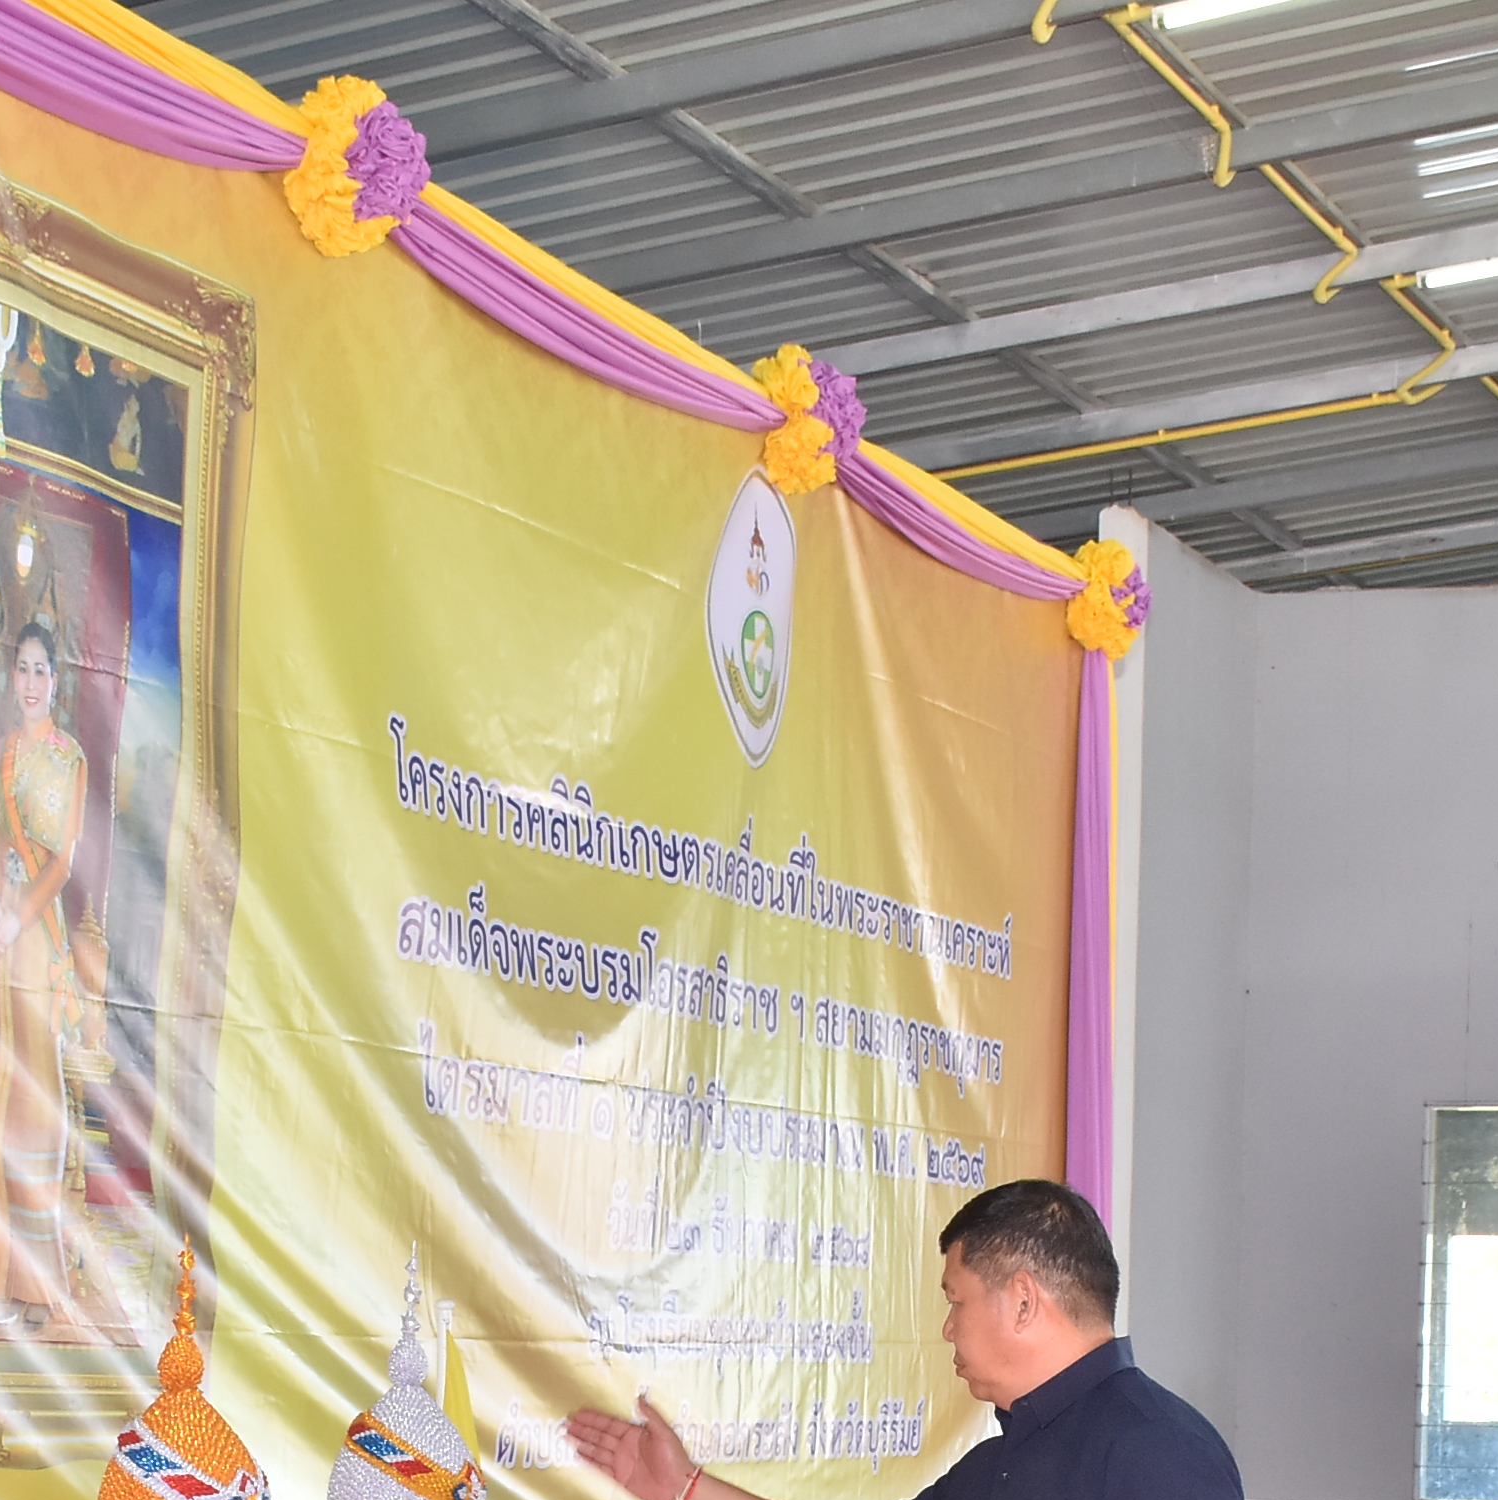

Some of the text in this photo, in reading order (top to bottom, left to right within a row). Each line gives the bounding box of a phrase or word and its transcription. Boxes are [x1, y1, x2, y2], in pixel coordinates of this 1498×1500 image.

[389, 713, 1012, 980] โครงการคลินิกเกษตรเคลื่อนที่ในพระราชานุเคราะห์
[399, 884, 778, 1034] สมเด็จพระบรมโอรสาธิราช
[815, 997, 1002, 1096] สยามมกุฎราชกุมาร
[419, 1021, 581, 1131] ไตรมาสที่
[925, 1136, 985, 1188] ๒๕๖๙
